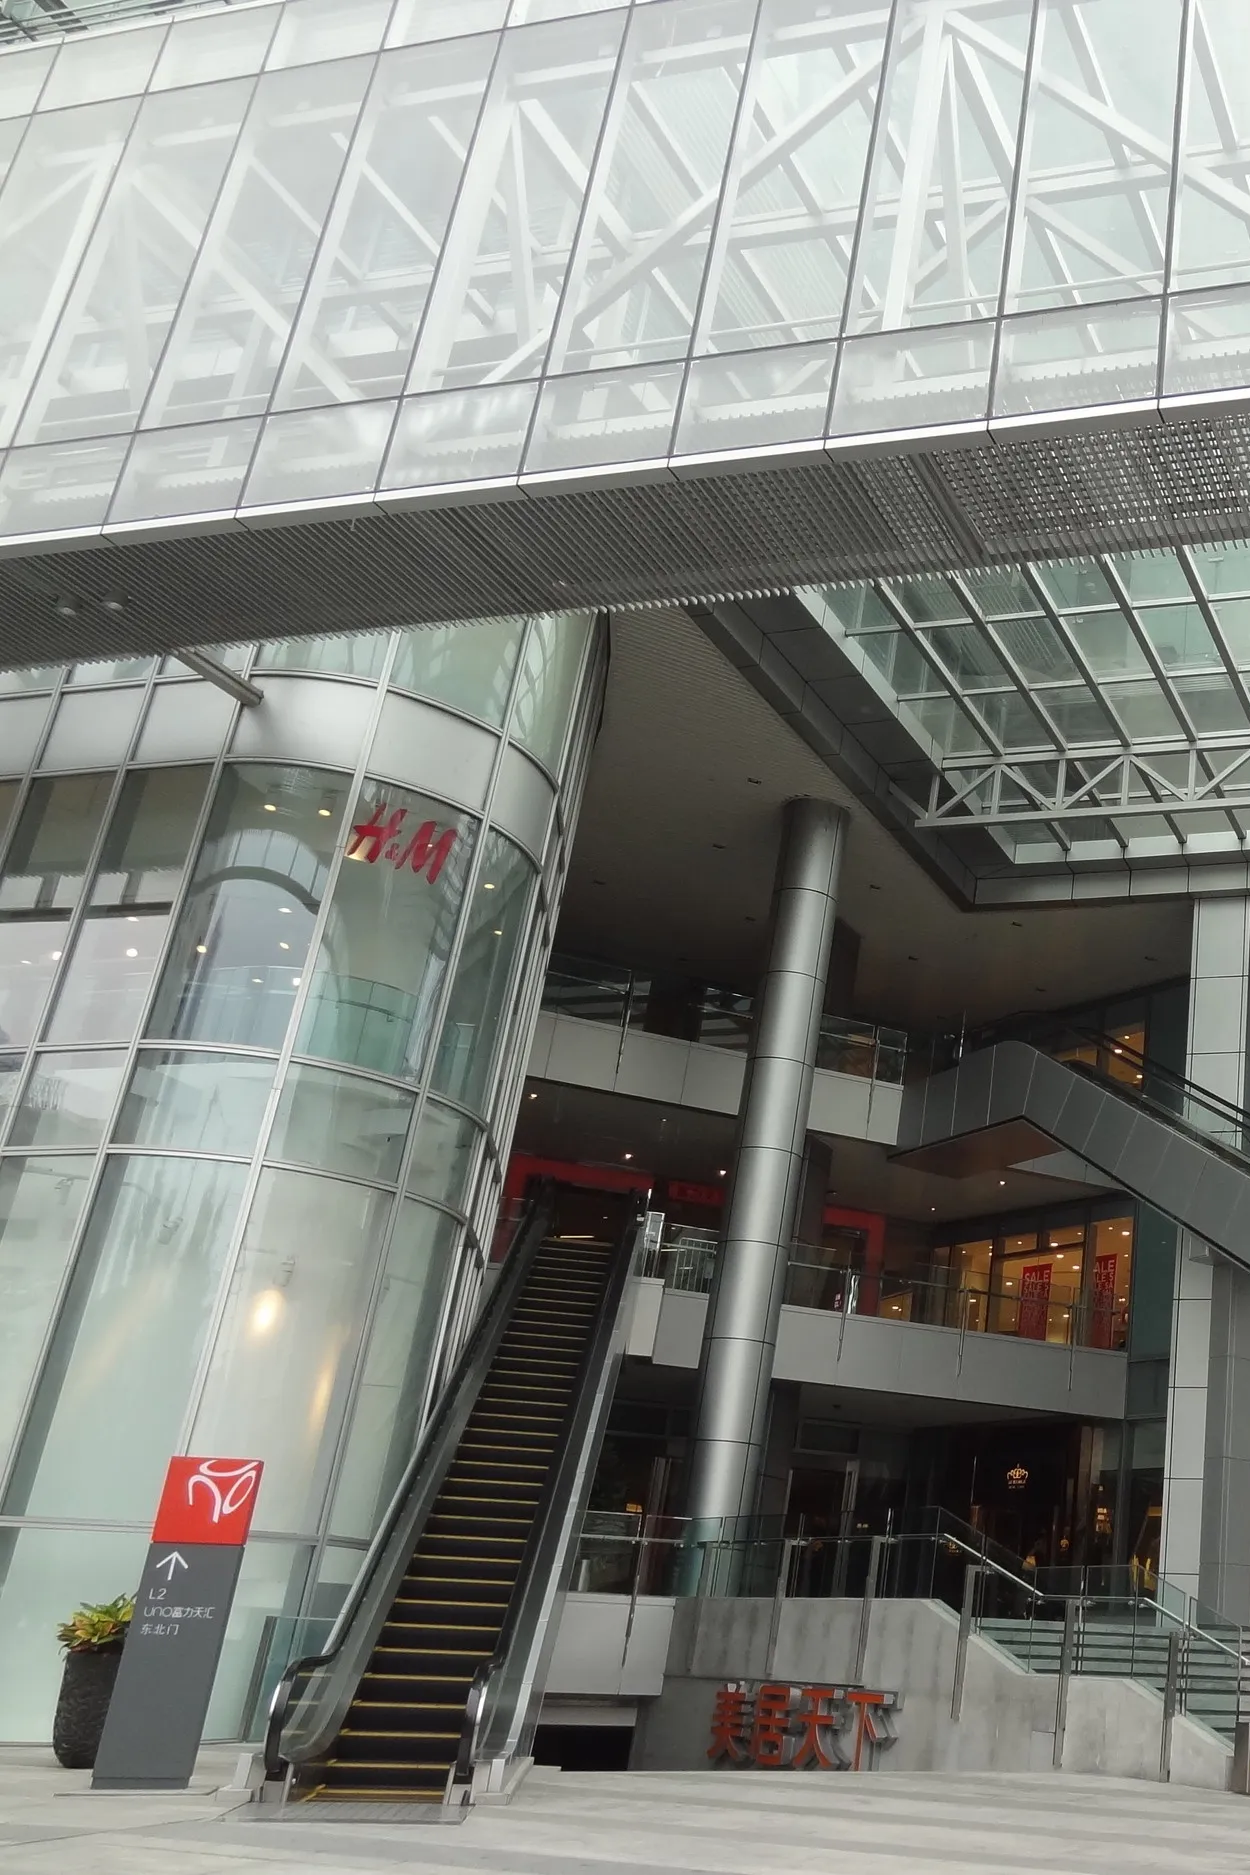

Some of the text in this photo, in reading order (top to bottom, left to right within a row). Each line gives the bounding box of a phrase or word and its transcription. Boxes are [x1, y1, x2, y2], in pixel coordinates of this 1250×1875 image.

[347, 802, 457, 885] H&M
[149, 1588, 167, 1600] L2
[140, 1624, 180, 1636] 东北门
[706, 1683, 892, 1771] 美居天下
